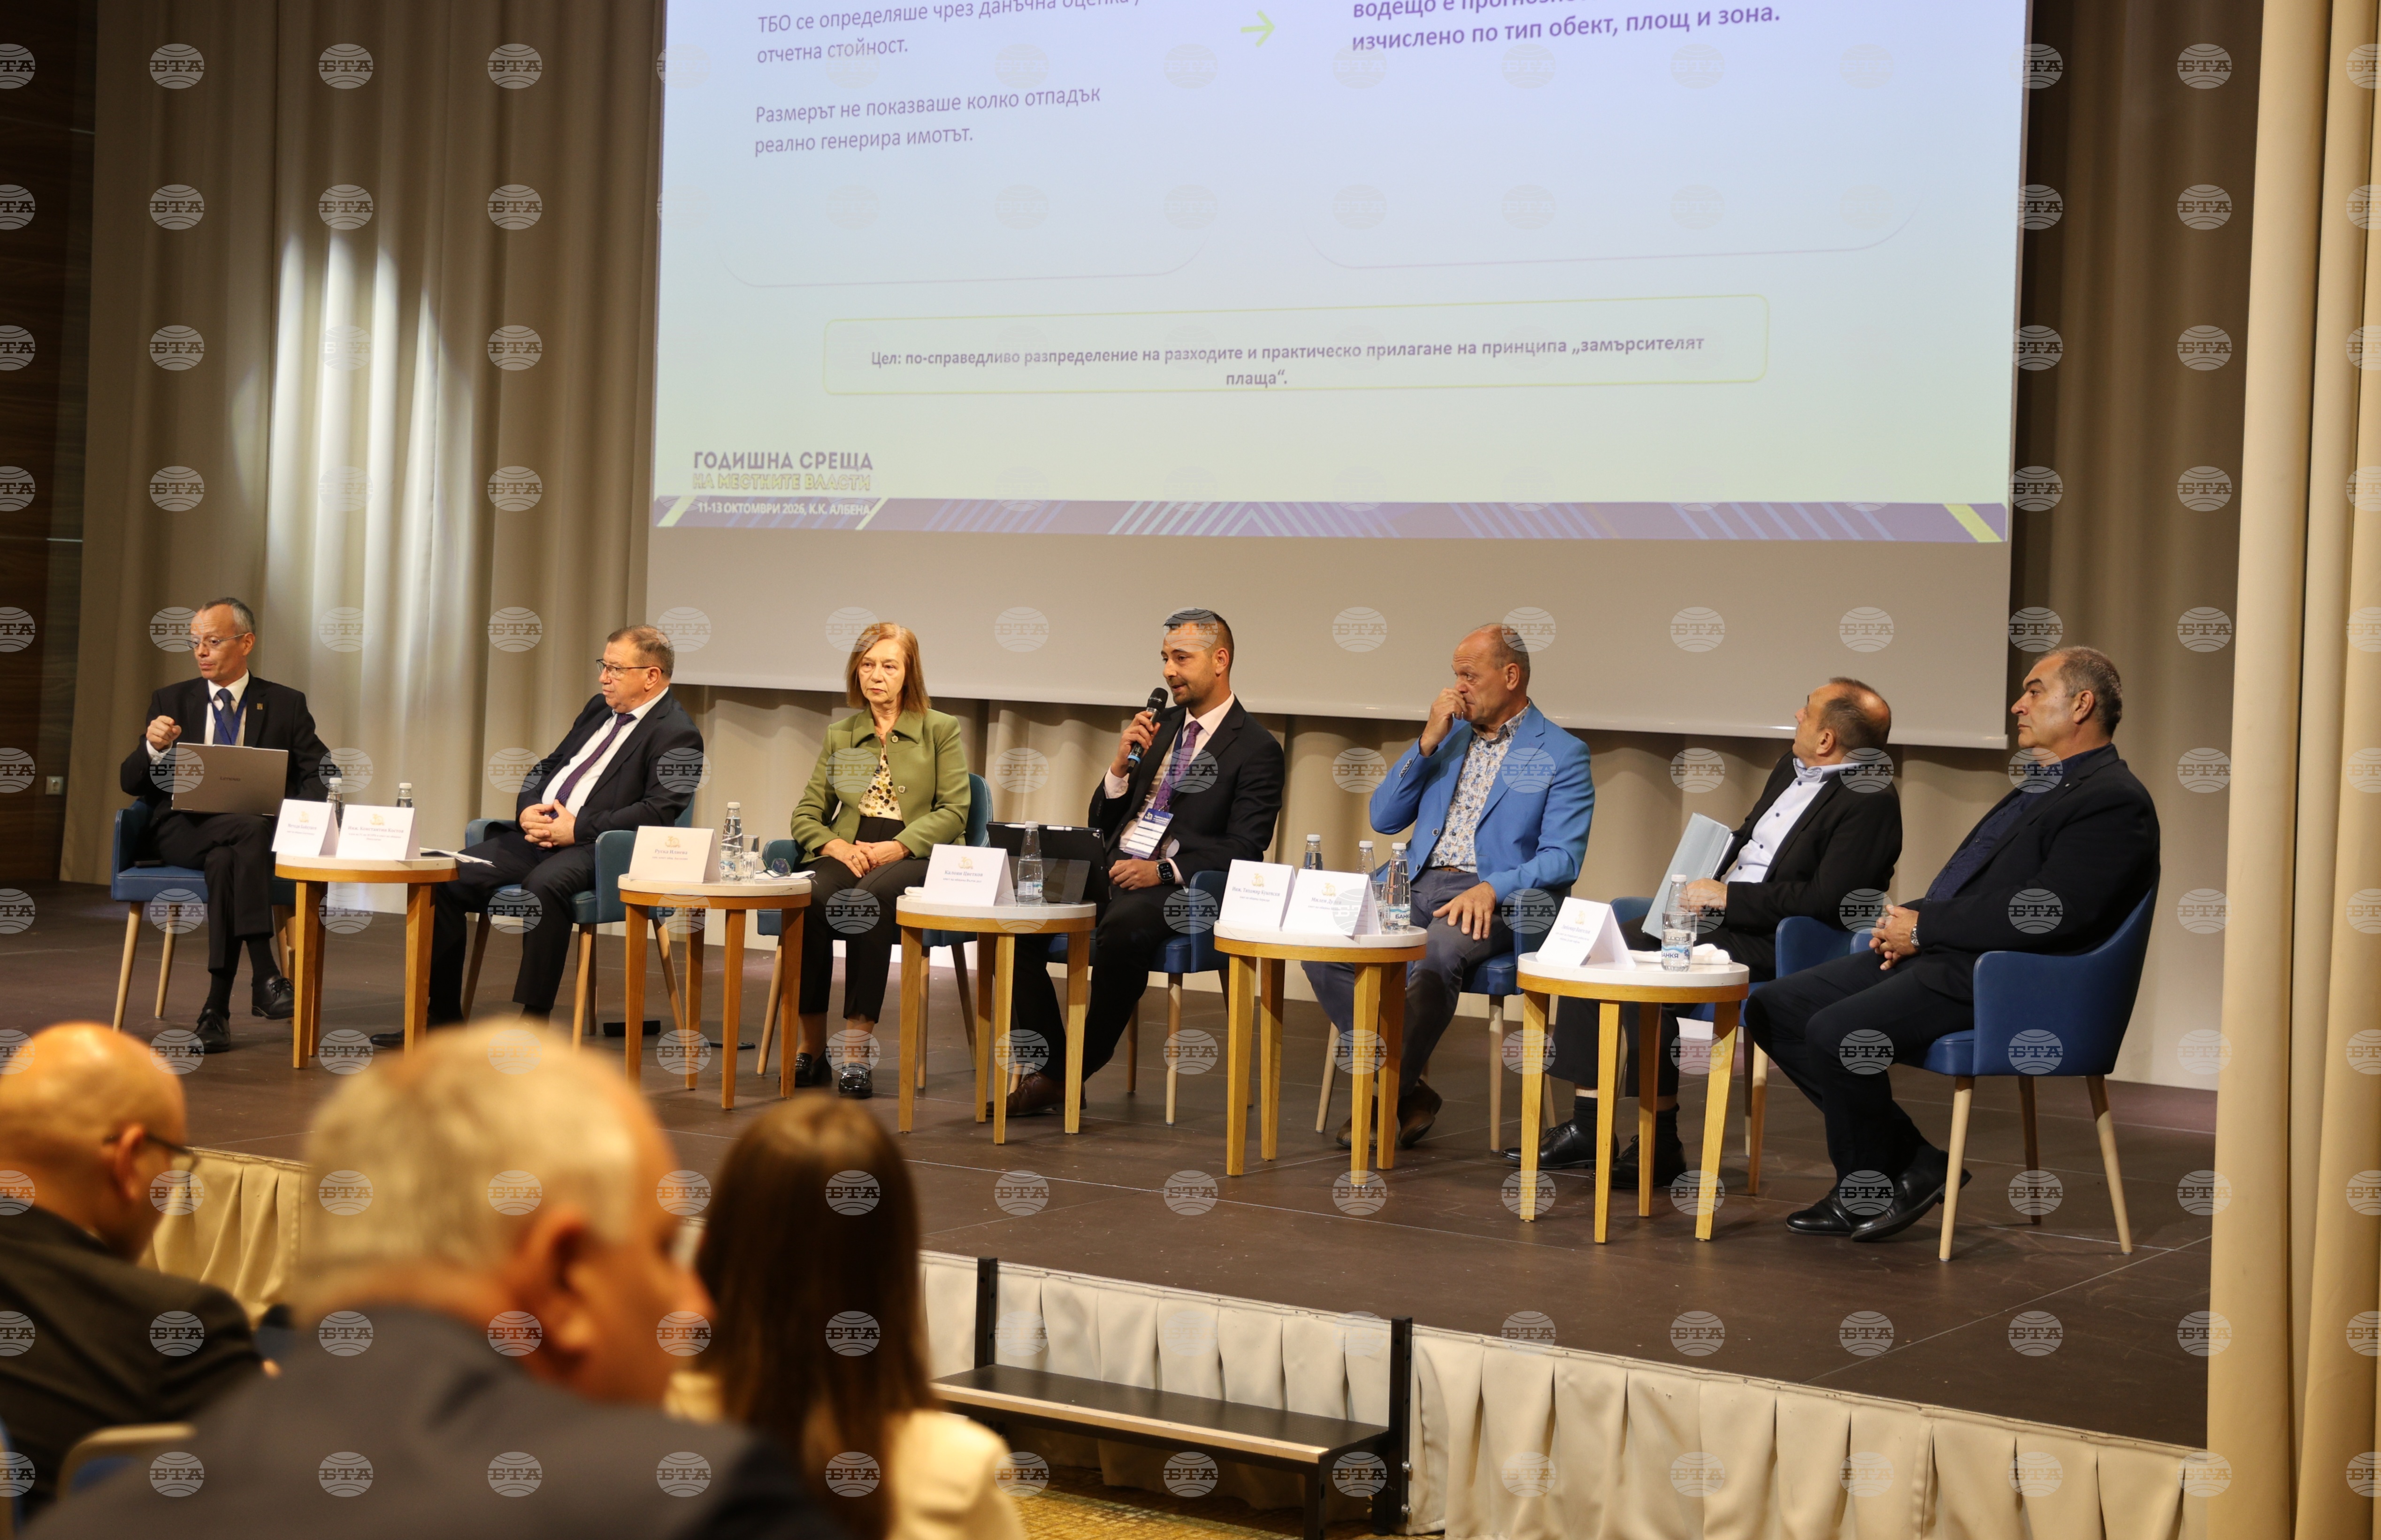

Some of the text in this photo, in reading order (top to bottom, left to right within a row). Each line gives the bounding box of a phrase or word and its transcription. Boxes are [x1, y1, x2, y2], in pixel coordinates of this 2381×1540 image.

[758, 15, 791, 32] ТБО
[796, 16, 814, 30] се
[819, 6, 927, 30] определяше
[934, 3, 973, 22] чрез
[1354, 0, 1436, 21] водещо
[1353, 7, 1779, 51] изчислено по тип обект, площ и зона.
[758, 38, 908, 63] отчетна стойност.
[756, 88, 1100, 124] Размерът не показваше колко отпадък
[755, 128, 972, 157] реално генерира имотът.
[872, 338, 1704, 368] Цел: по-справедливо разпределение на разходите и практическо прилагане на принципа „замърсителят
[1226, 369, 1287, 389] плаща“.
[694, 452, 873, 471] ГОДИШНА СРЕЩА
[693, 474, 871, 490] НА МЕСТНИТЕ ВЛАСТИ
[698, 502, 723, 513] 11-13
[723, 502, 781, 514] ОКТОМВРИ
